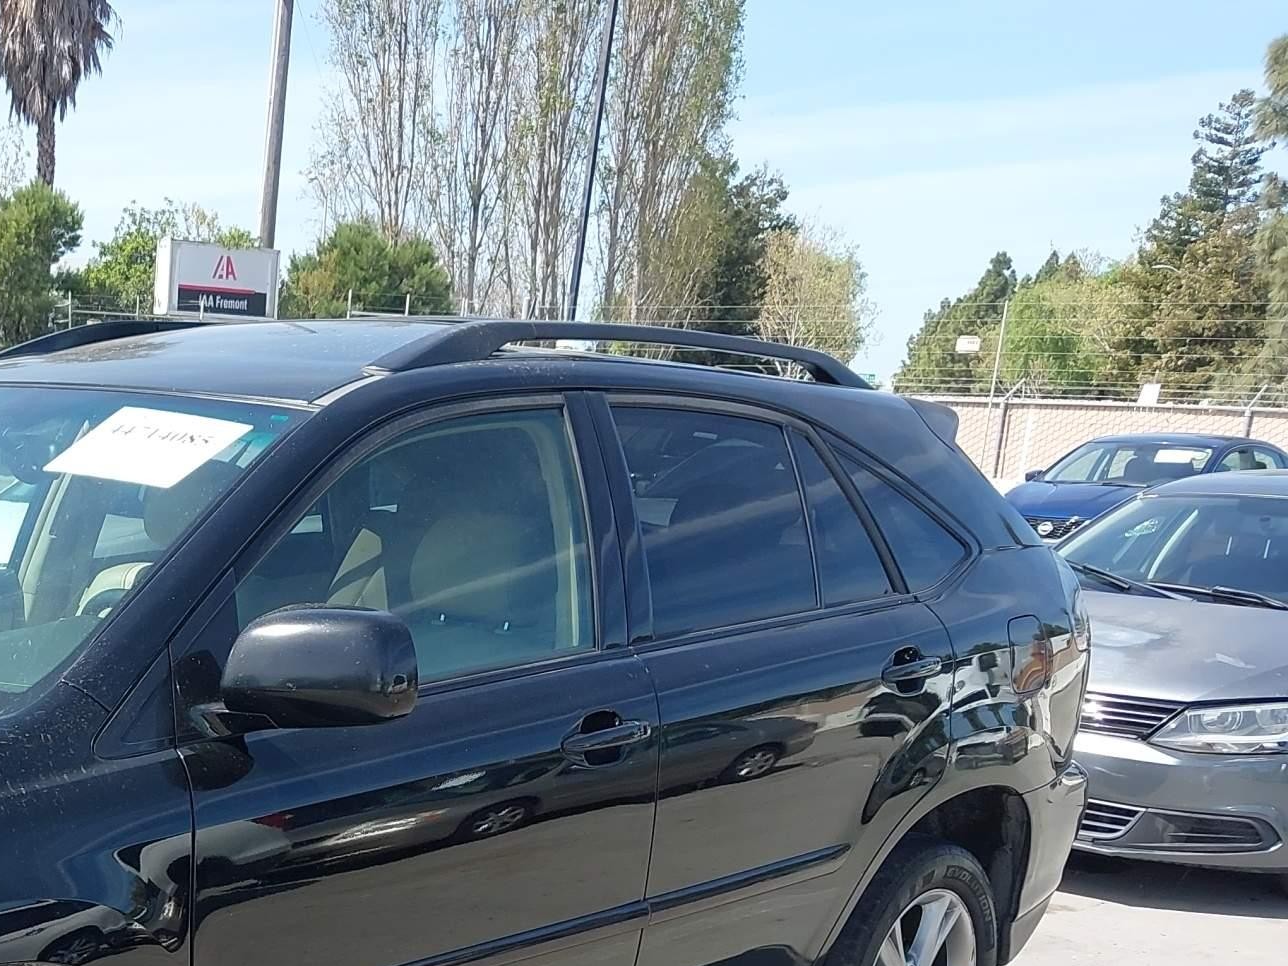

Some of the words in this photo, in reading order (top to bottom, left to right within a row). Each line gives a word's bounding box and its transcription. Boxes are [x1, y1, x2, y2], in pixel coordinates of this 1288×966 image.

[198, 293, 214, 308] IAA
[215, 296, 248, 311] Fremont
[112, 423, 215, 446] 44714085
[946, 868, 992, 921] EVOLUTION
